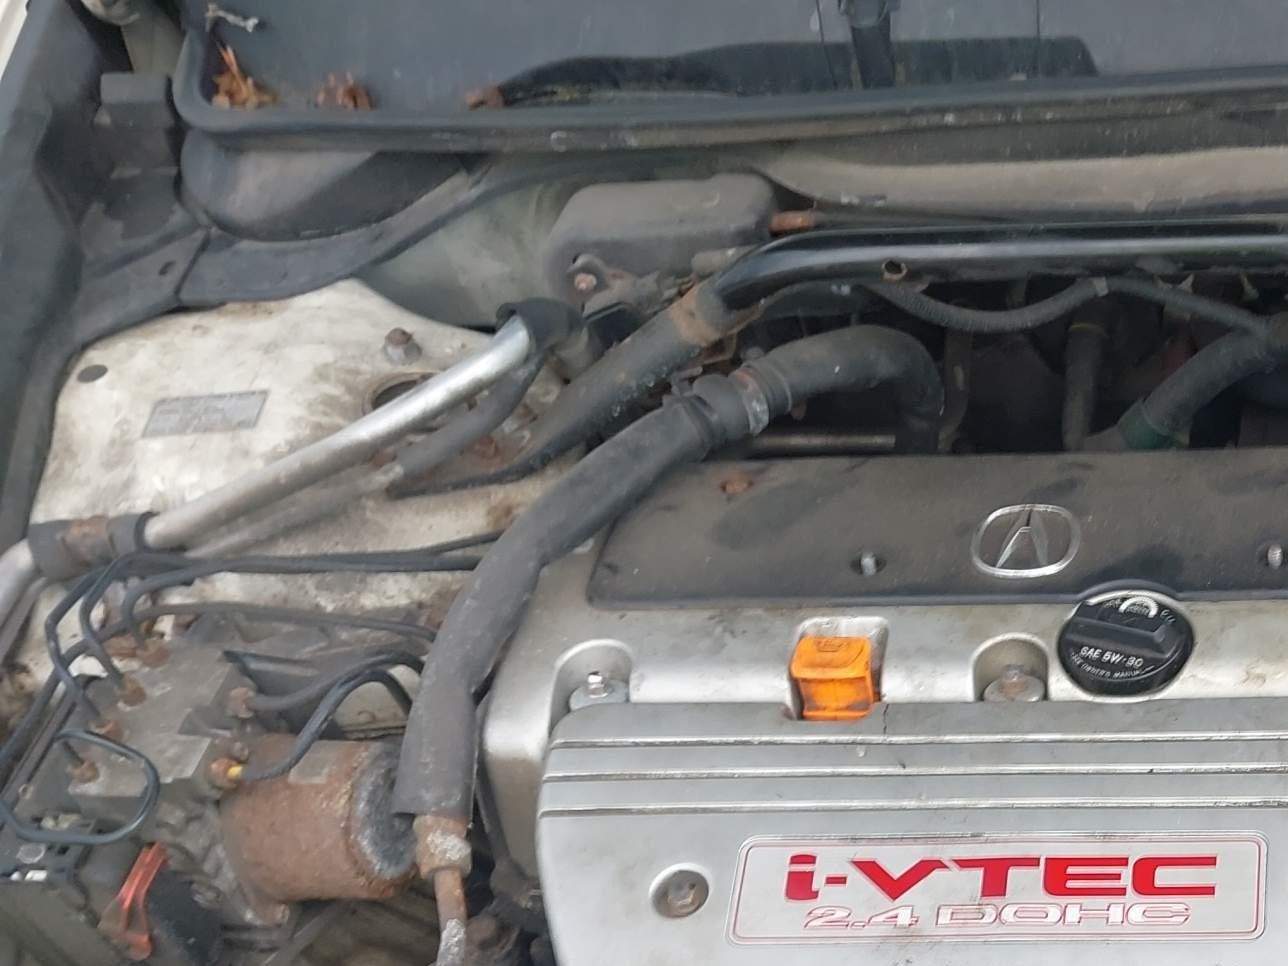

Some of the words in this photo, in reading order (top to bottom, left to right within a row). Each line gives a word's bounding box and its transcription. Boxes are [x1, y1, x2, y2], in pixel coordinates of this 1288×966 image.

[1103, 651, 1144, 668] 5W-30
[784, 853, 1217, 901] i-VTEC
[803, 904, 918, 928] 2.4
[936, 903, 1191, 926] DOHC
